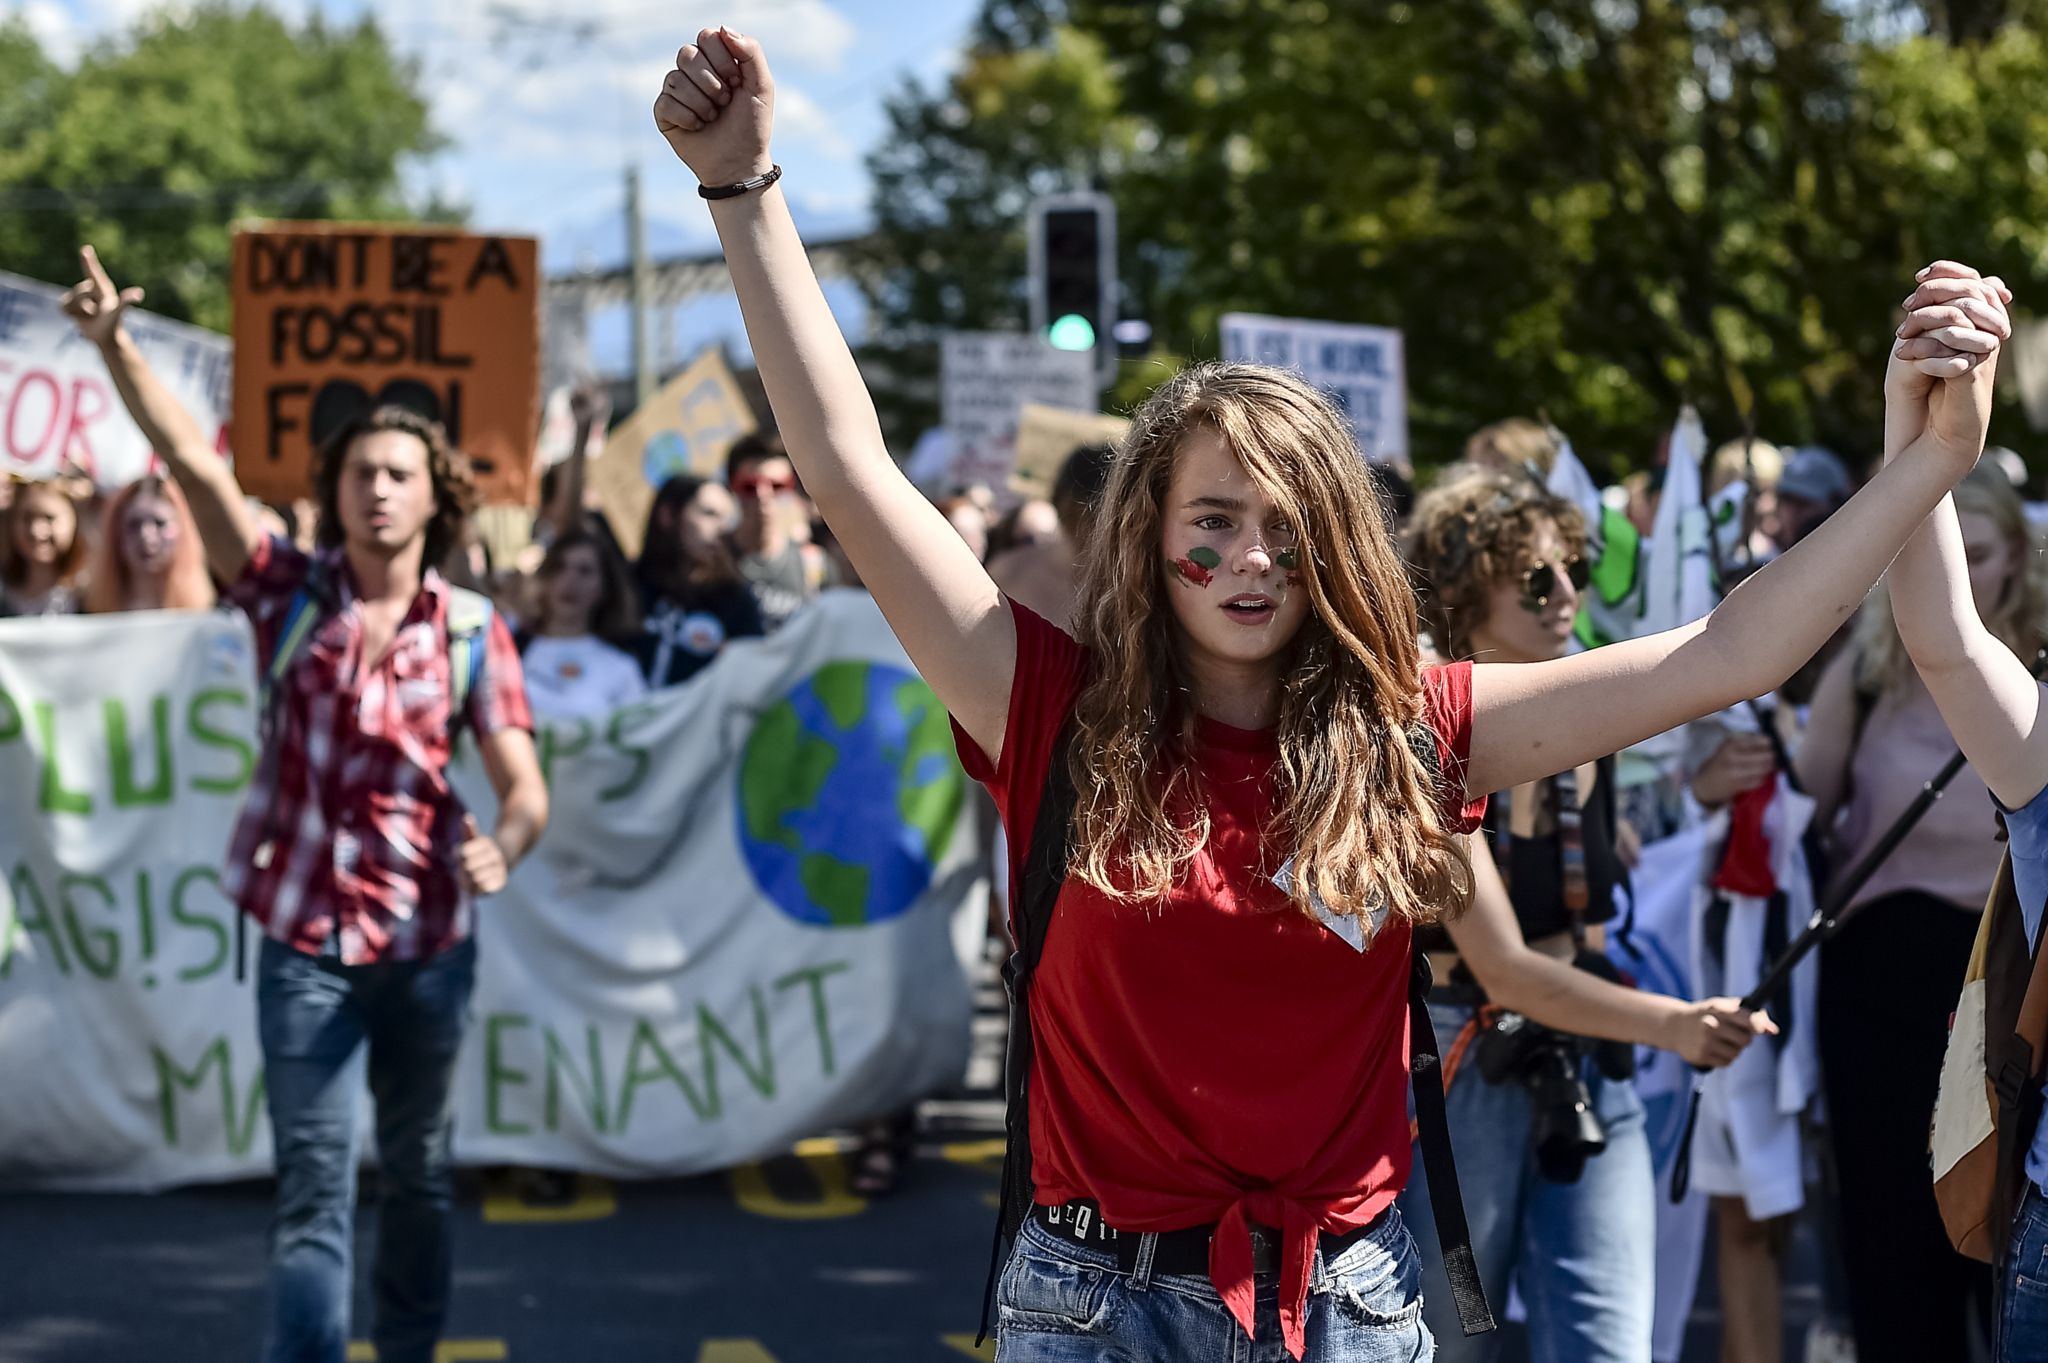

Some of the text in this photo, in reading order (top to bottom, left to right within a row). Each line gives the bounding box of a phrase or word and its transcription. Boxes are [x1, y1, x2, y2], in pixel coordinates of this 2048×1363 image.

[393, 235, 453, 295] BE
[464, 235, 521, 292] A
[269, 302, 475, 369] FOSSIL
